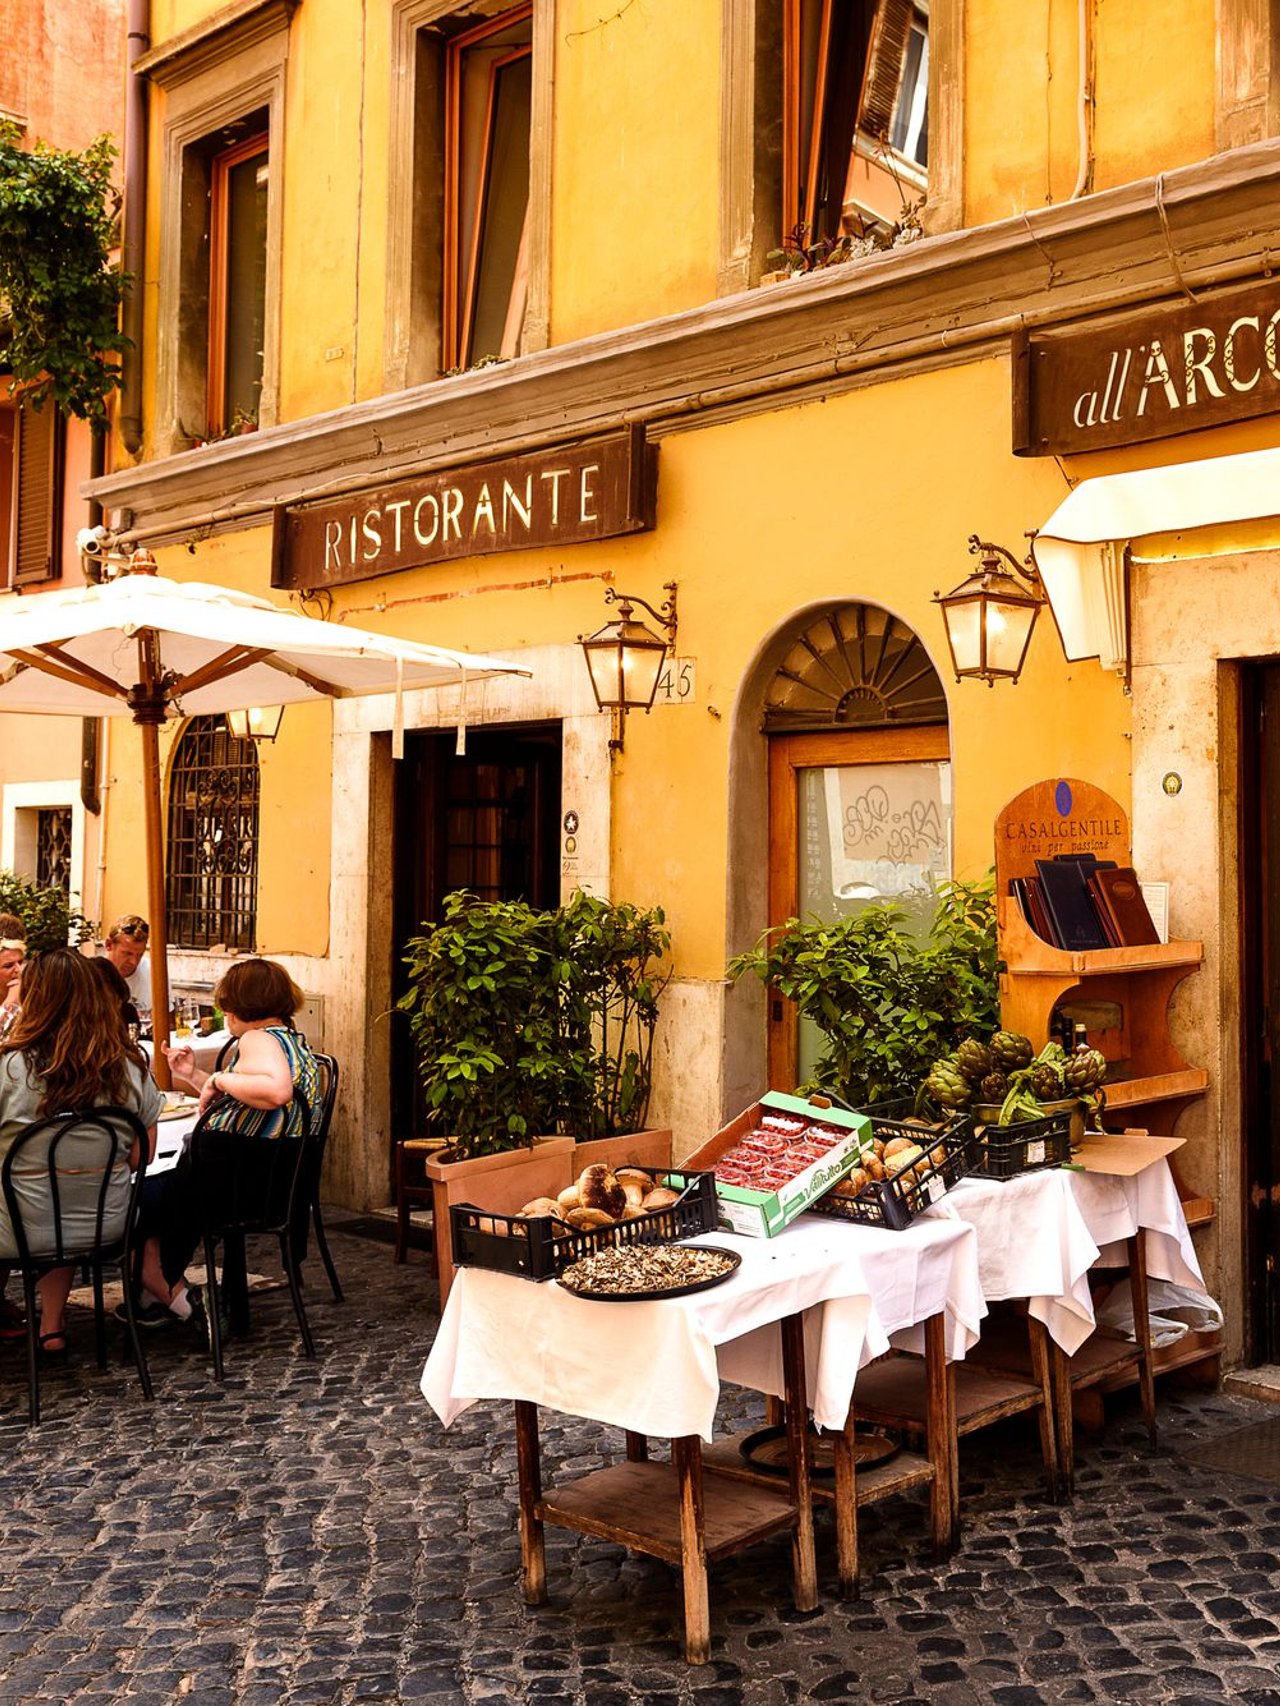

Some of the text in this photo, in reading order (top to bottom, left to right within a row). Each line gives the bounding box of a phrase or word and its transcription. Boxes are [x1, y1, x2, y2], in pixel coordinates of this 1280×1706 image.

[325, 465, 599, 569] RISTORANTE
[657, 664, 692, 698] 45
[1005, 819, 1121, 839] CASALGENTILE
[1046, 841, 1063, 857] per
